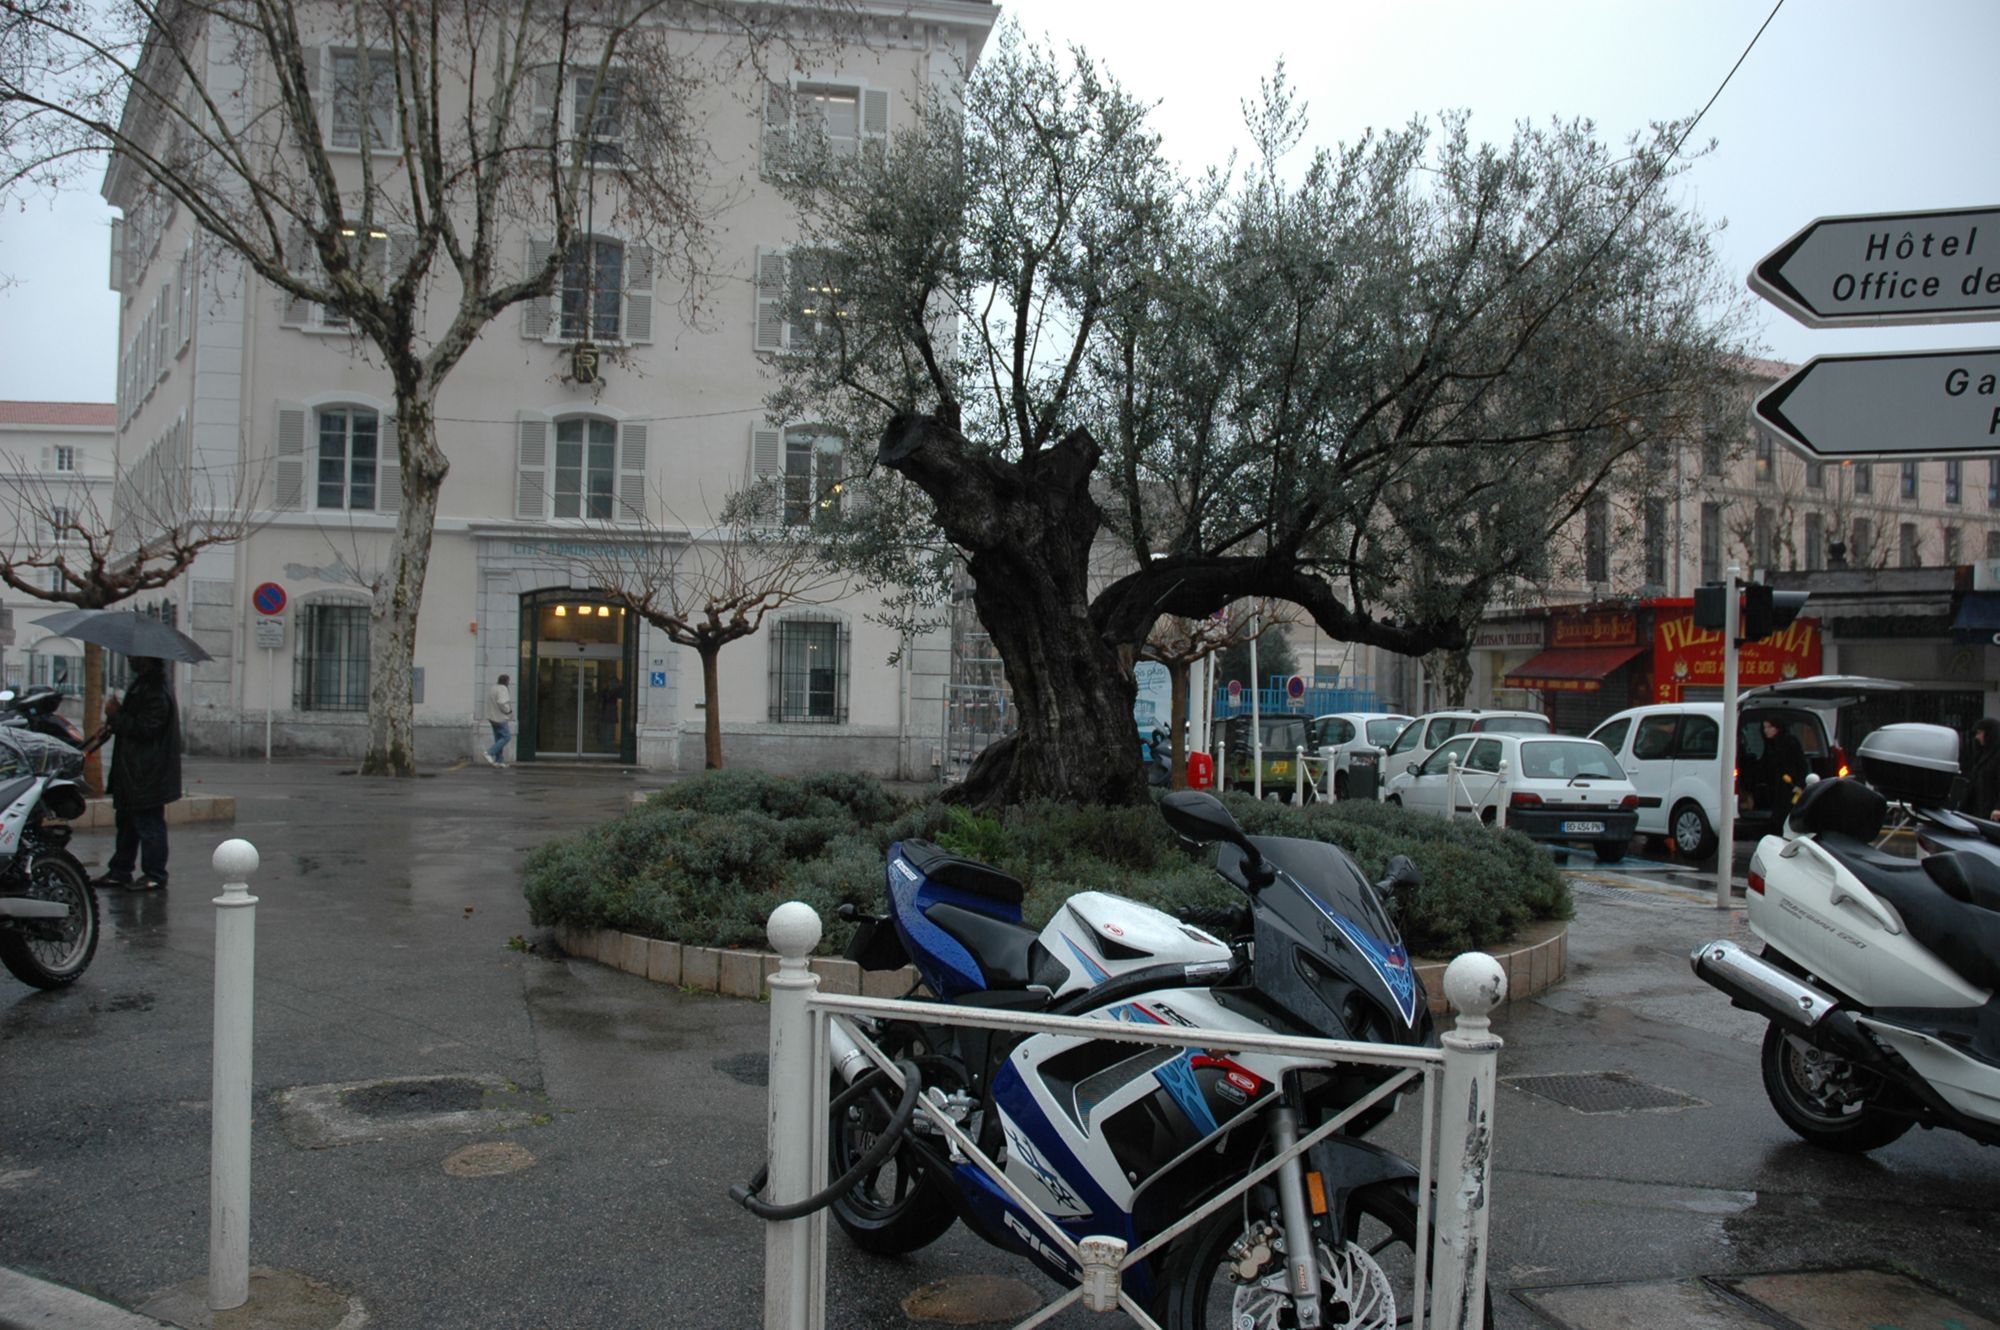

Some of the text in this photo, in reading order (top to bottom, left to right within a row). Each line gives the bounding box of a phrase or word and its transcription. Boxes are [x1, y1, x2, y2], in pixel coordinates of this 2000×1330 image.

[1865, 227, 1977, 262] Hôtel
[1832, 267, 2000, 301] Office de
